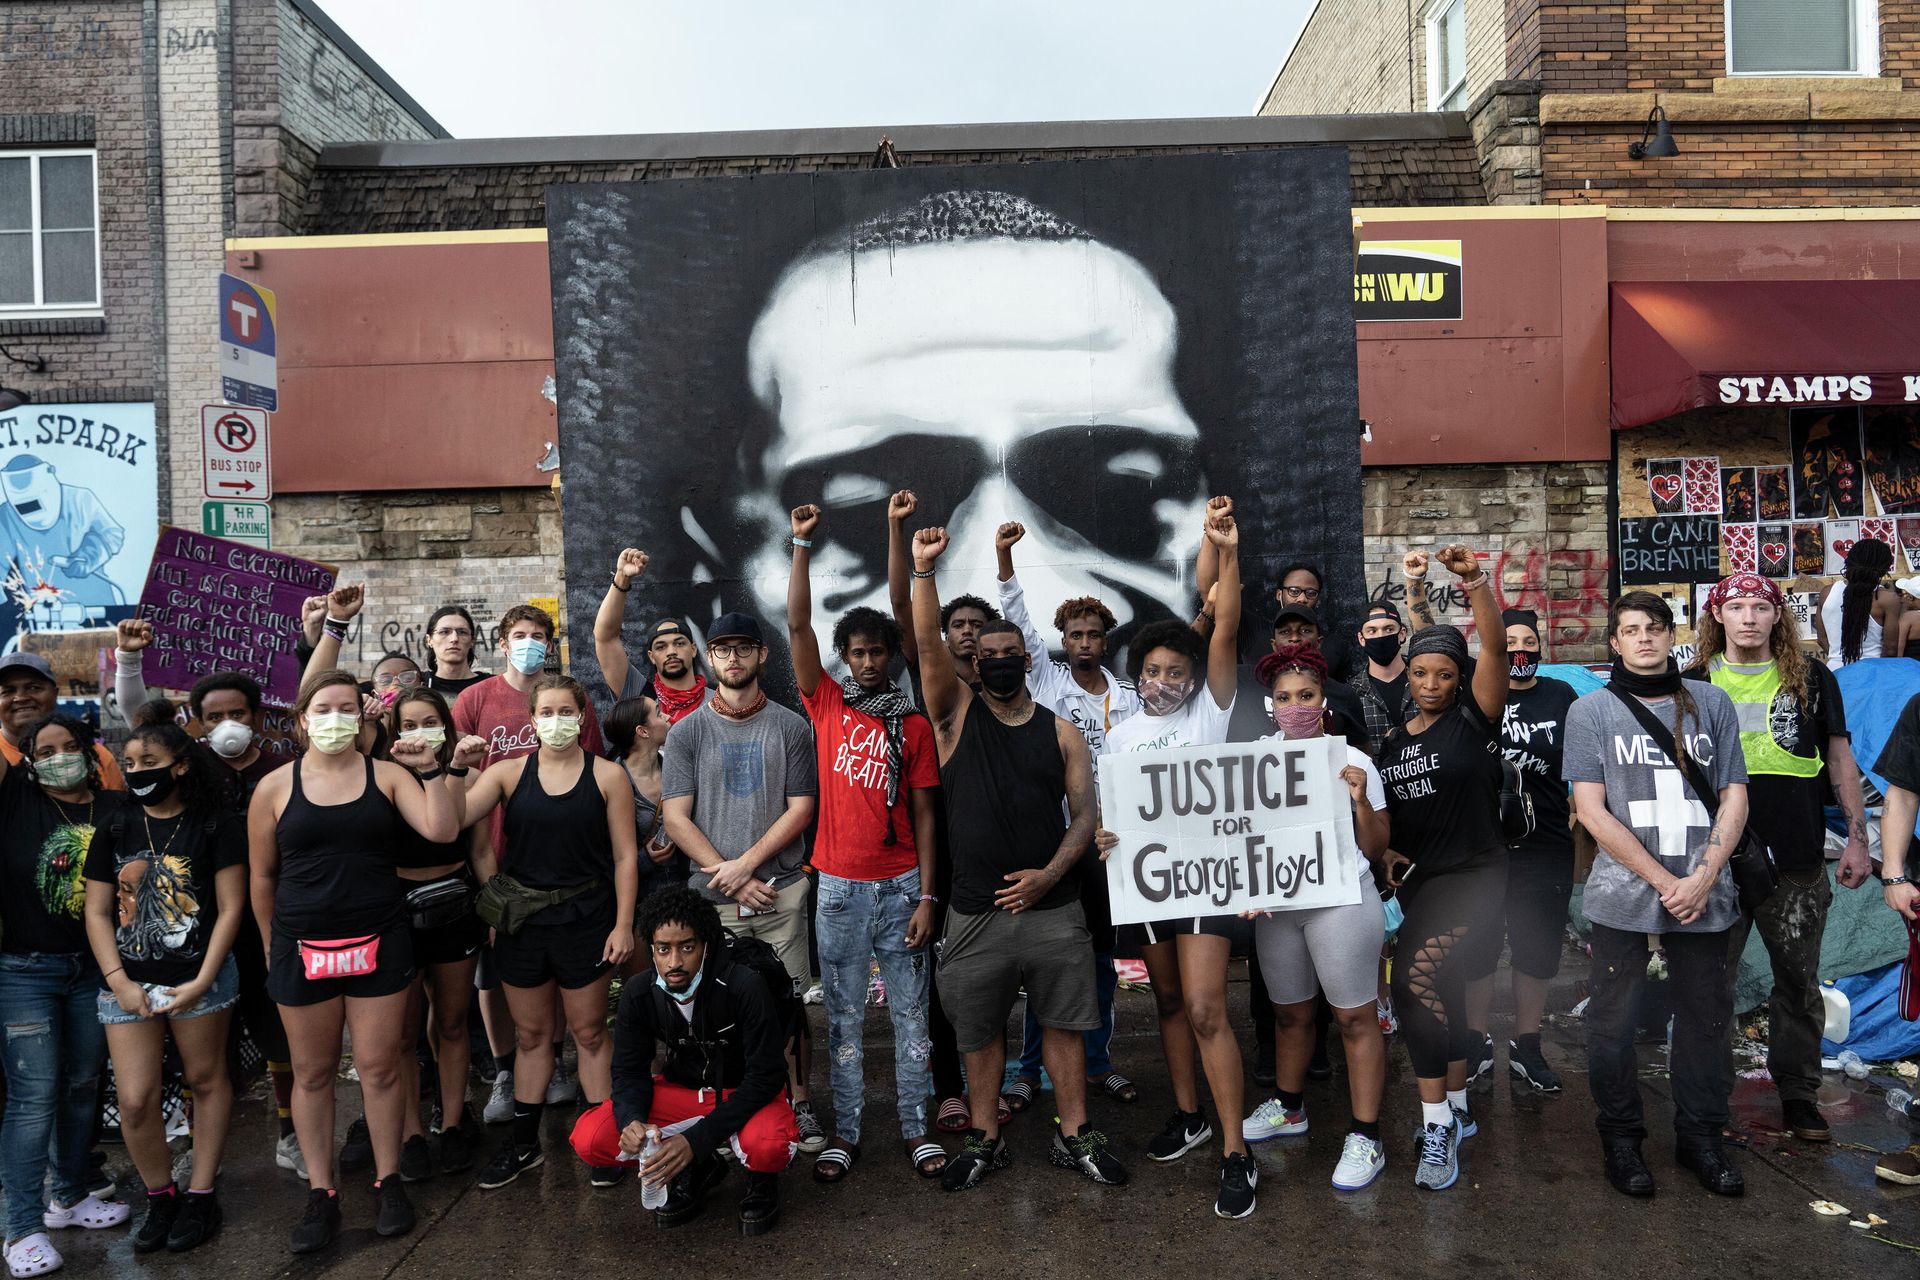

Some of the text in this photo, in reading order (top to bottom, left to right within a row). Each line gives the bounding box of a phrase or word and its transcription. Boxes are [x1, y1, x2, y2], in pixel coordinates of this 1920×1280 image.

[232, 348, 239, 360] 5
[1719, 375, 1872, 403] STAMPS
[36, 414, 148, 467] SPARK
[211, 459, 262, 473] BUS STOP
[209, 507, 254, 531] 1 HR
[225, 521, 267, 534] PARKING
[1622, 521, 1639, 543] I
[1622, 545, 1719, 571] BREATHE
[1502, 717, 1557, 745] AN'T
[1401, 743, 1422, 761] THE
[1614, 734, 1713, 767] MEIC
[833, 742, 890, 790] BREATH
[1380, 753, 1440, 784] STRUGGLE
[1138, 750, 1308, 822] JUSTICE
[1393, 777, 1437, 800] IS REAL
[1212, 816, 1252, 836] FOR
[311, 947, 369, 975] PINK
